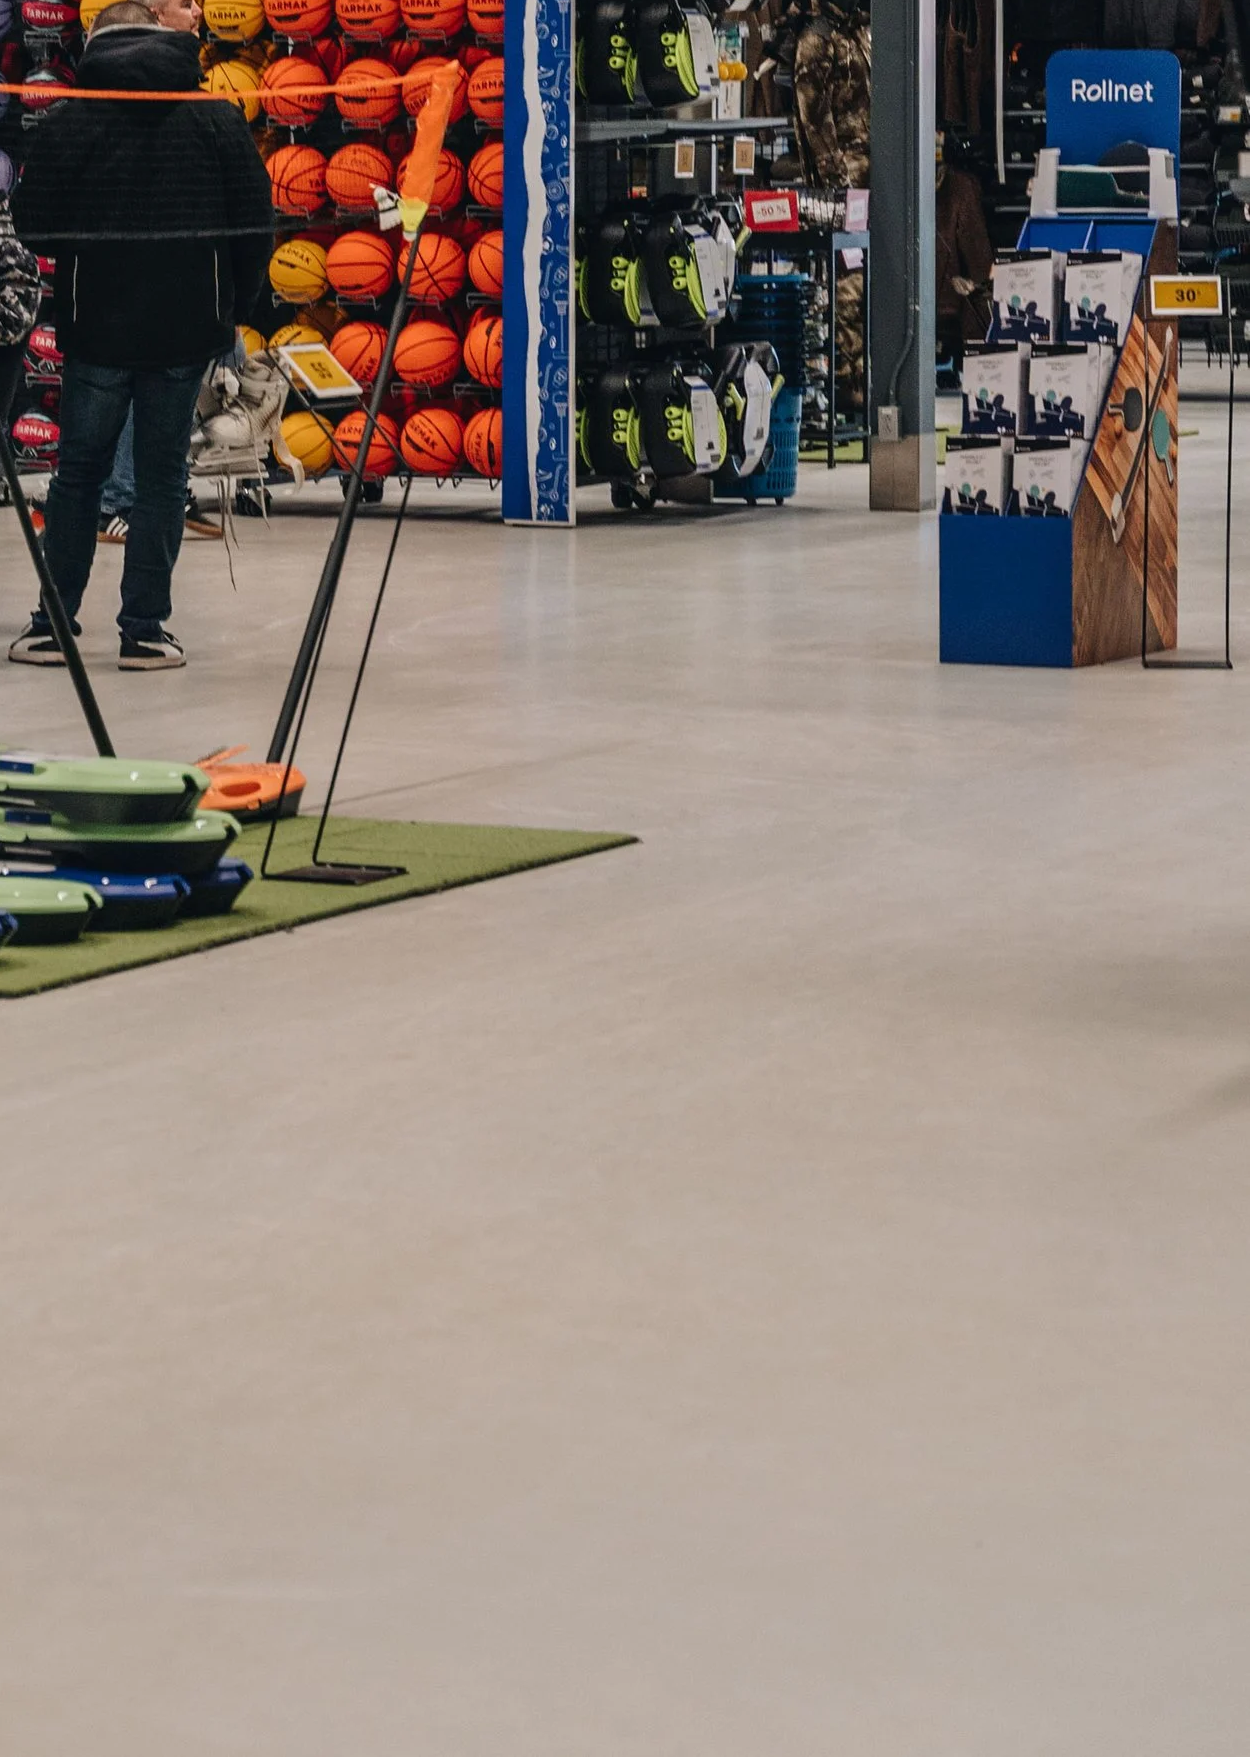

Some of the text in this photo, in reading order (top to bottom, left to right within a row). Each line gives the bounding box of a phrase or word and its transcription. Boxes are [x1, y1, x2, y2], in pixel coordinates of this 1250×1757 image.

[269, 0, 308, 11] TARMAK
[340, 3, 382, 13] TARMAK
[26, 8, 64, 20] TARMAK
[209, 10, 246, 21] TARMAK
[1072, 79, 1154, 103] Rollnet
